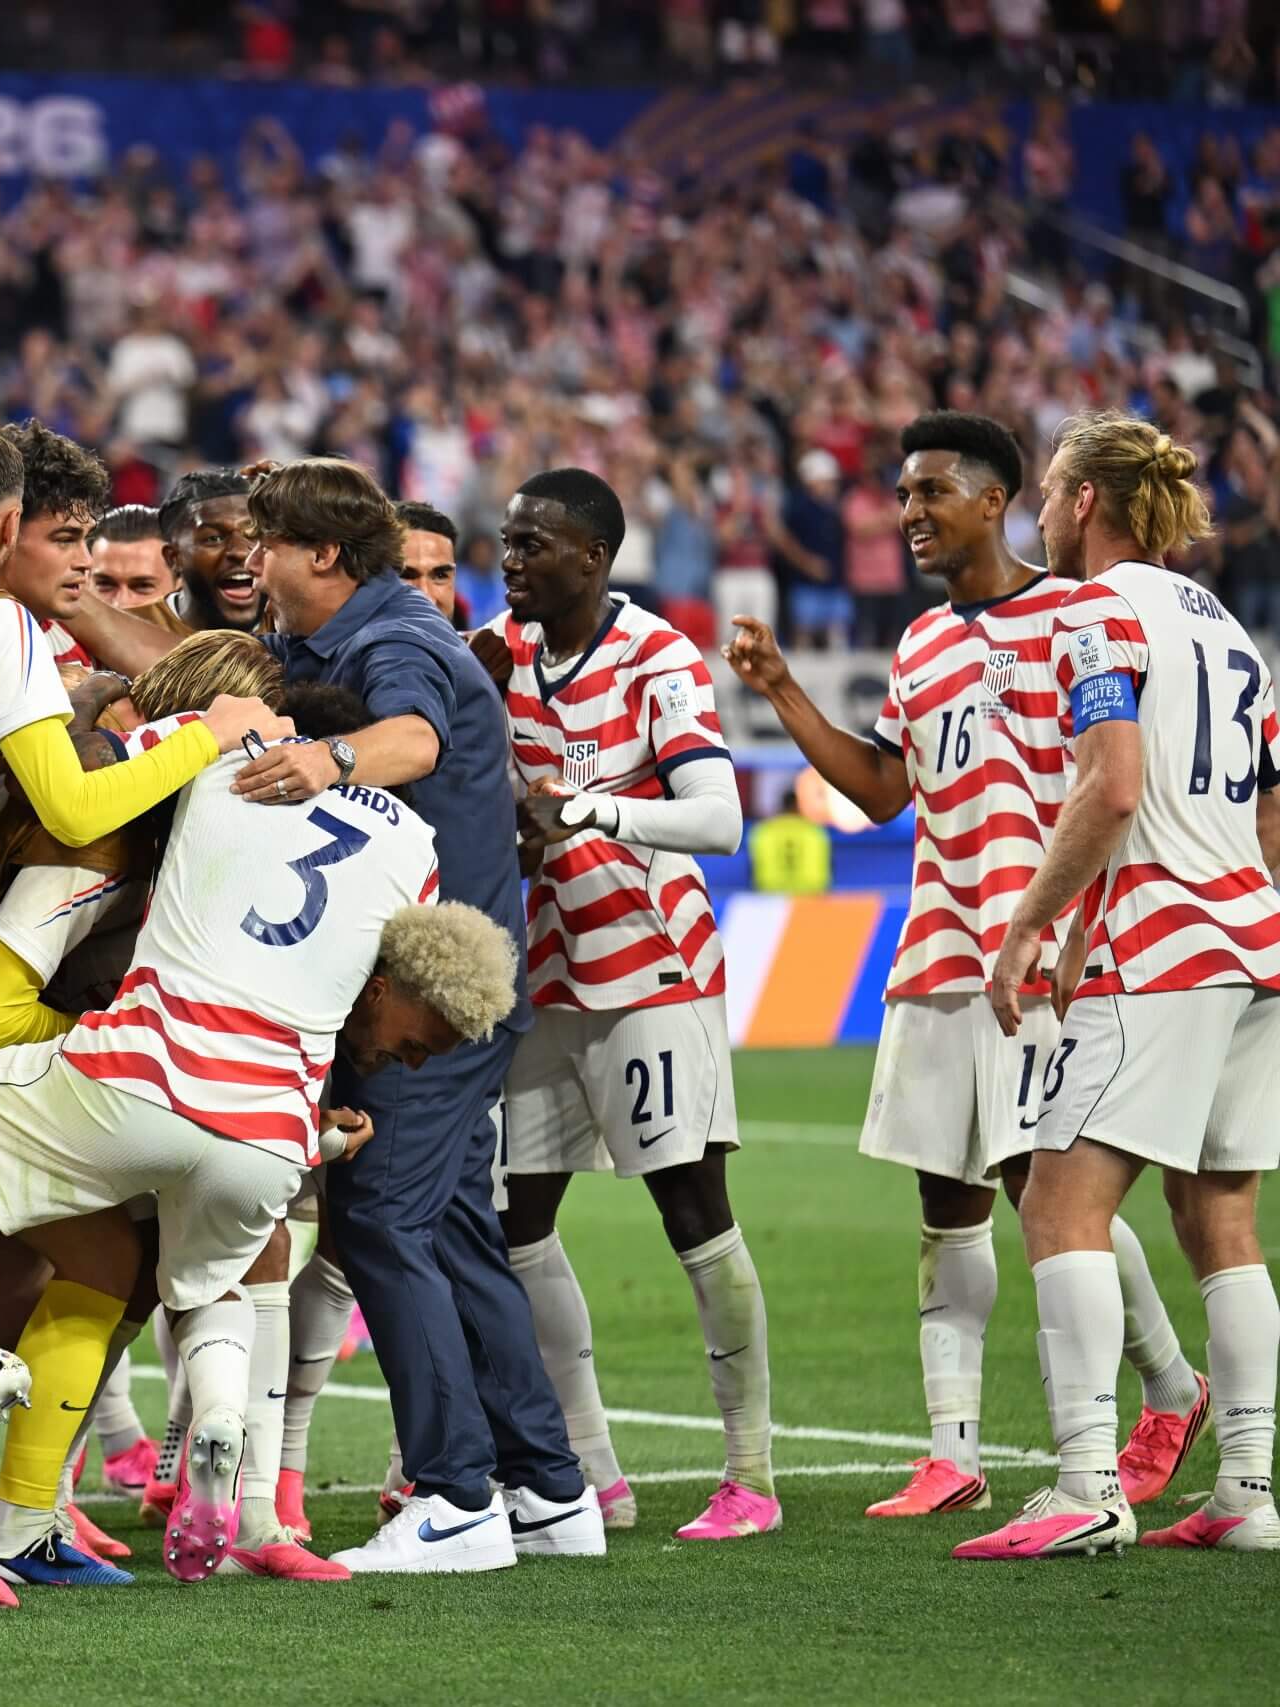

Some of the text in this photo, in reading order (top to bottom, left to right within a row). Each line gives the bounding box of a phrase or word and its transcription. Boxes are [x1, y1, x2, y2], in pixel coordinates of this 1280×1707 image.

[988, 653, 1015, 670] USA
[1081, 677, 1120, 693] FOOTBALL
[1082, 686, 1121, 705] UNITES
[1094, 696, 1124, 710] World
[1189, 638, 1260, 803] 13
[937, 705, 975, 773] 16
[566, 743, 596, 762] USA
[239, 806, 372, 946] 3
[625, 1051, 674, 1125] 21
